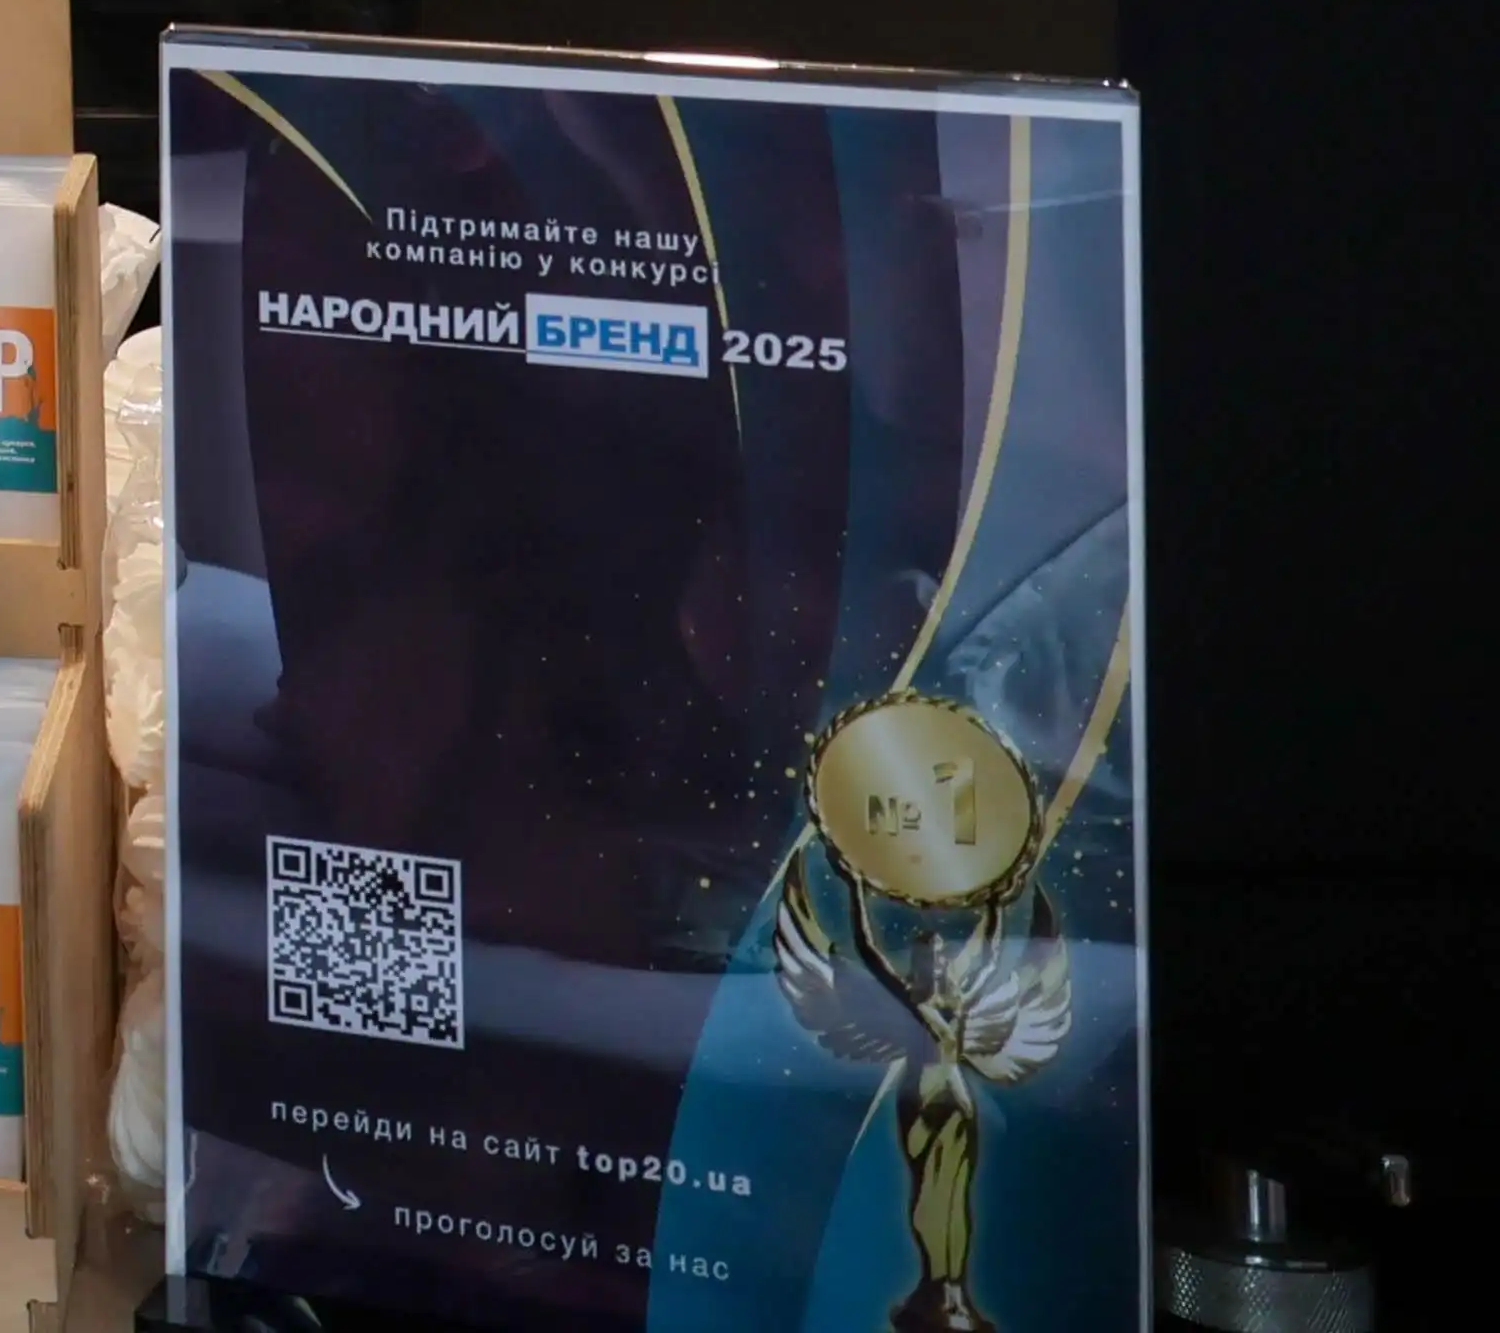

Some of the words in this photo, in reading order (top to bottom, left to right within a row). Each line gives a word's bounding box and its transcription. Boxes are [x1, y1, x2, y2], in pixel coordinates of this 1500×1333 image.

[366, 241, 523, 270] компанію
[537, 252, 554, 277] у
[569, 254, 721, 287] конкурсі
[386, 207, 599, 247] Підтримайте
[614, 229, 701, 256] нашу
[258, 291, 520, 344] НАРОДНИЙ
[536, 314, 701, 366] БРЕНД
[722, 331, 848, 372] 2025
[270, 1102, 412, 1141] перейди
[429, 1125, 467, 1151] на
[483, 1134, 562, 1165] сайт
[576, 1145, 752, 1197] top20.ua
[395, 1206, 599, 1261] проголосуй
[615, 1242, 651, 1269] за
[669, 1253, 730, 1282] нас
